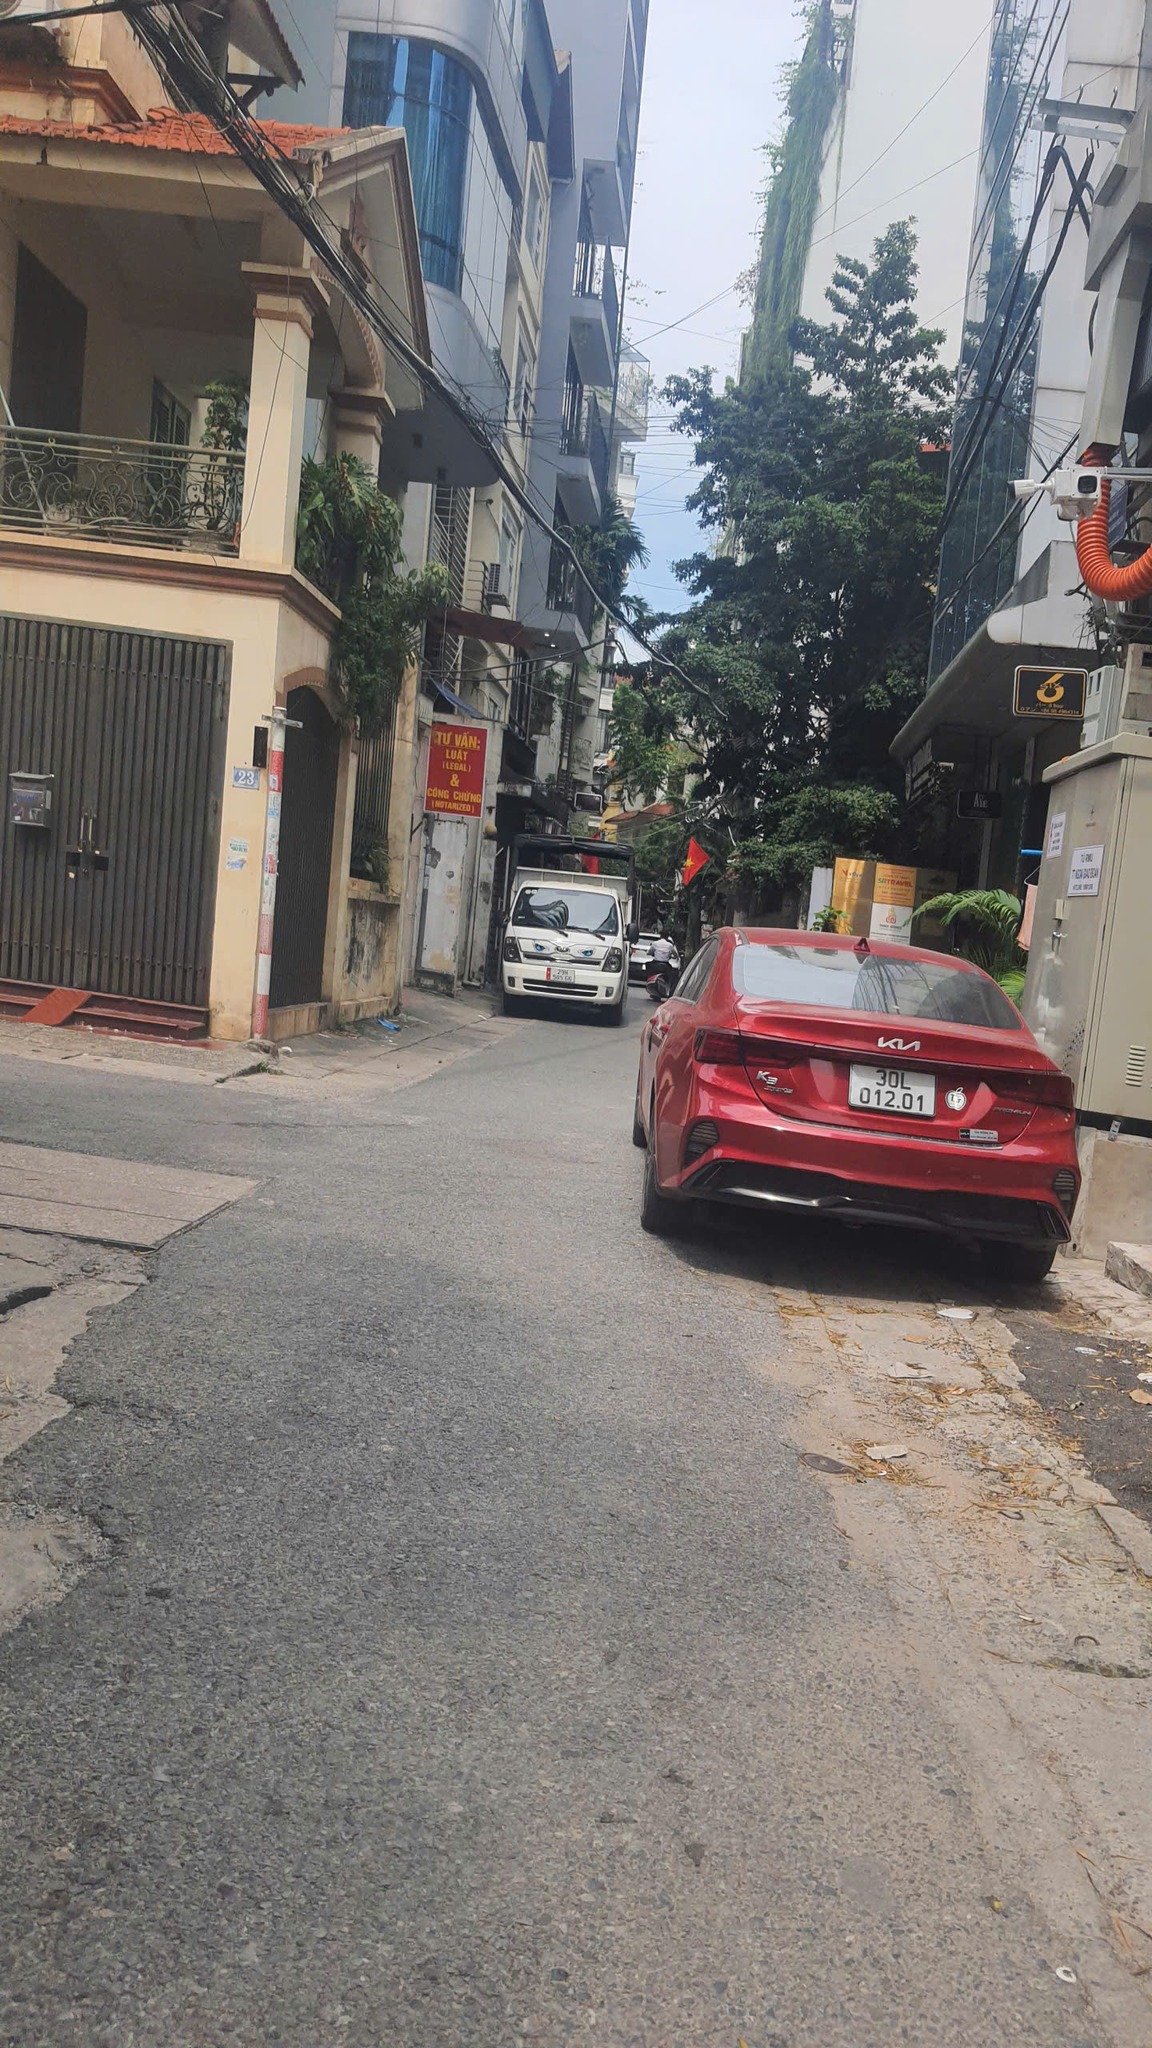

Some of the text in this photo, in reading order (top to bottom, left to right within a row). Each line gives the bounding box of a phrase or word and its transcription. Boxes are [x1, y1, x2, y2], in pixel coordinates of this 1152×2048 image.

[1037, 673, 1064, 703] 6
[436, 731, 481, 749] TƯ VẤN:
[445, 749, 468, 762] LUẬT
[238, 770, 255, 785] 23
[450, 773, 460, 787] &
[427, 787, 482, 803] CÔNG CHỨNG
[877, 1036, 921, 1052] KIA
[756, 1070, 779, 1085] K3
[875, 1069, 911, 1090] 30L
[859, 1087, 924, 1112] 012.01
